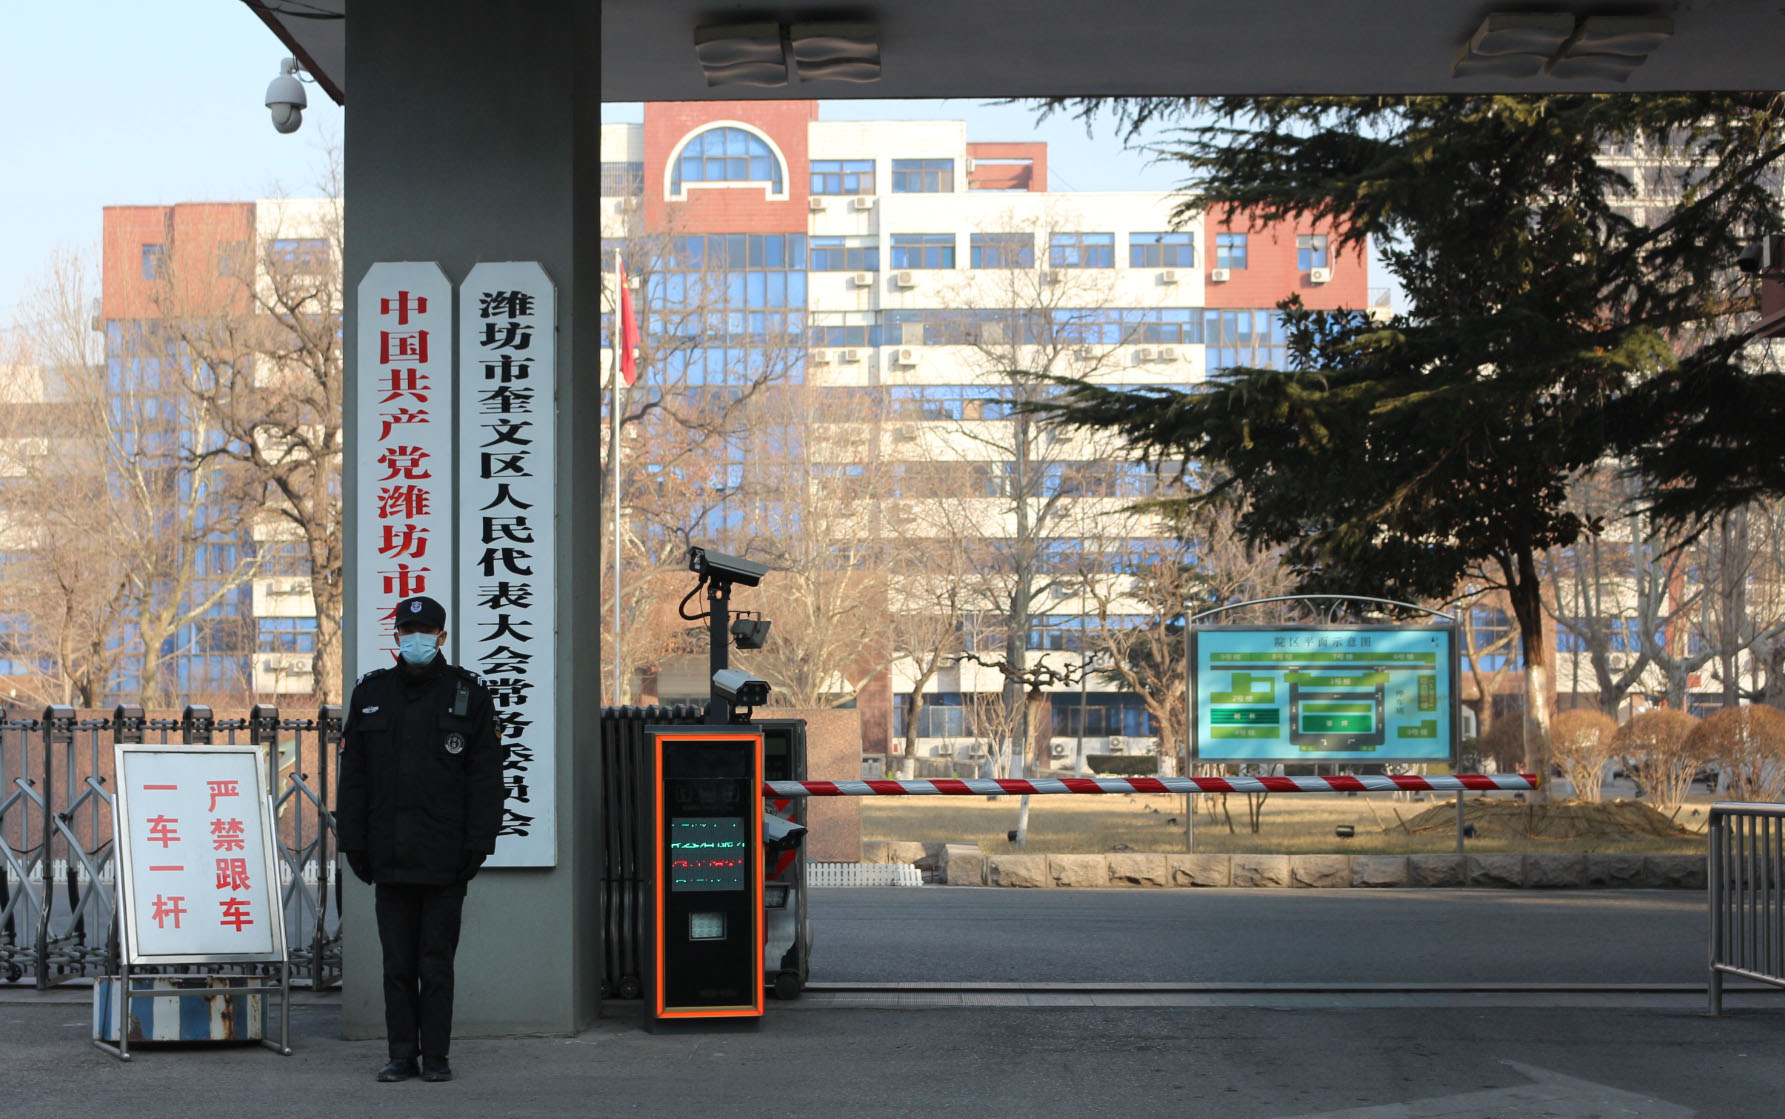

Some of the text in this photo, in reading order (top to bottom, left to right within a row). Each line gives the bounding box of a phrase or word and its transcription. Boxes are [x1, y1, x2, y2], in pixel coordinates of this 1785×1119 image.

[378, 291, 431, 662] 中国共产党潍坊市
[143, 784, 187, 929] 一车一杆
[207, 780, 254, 932] 严禁跟车
